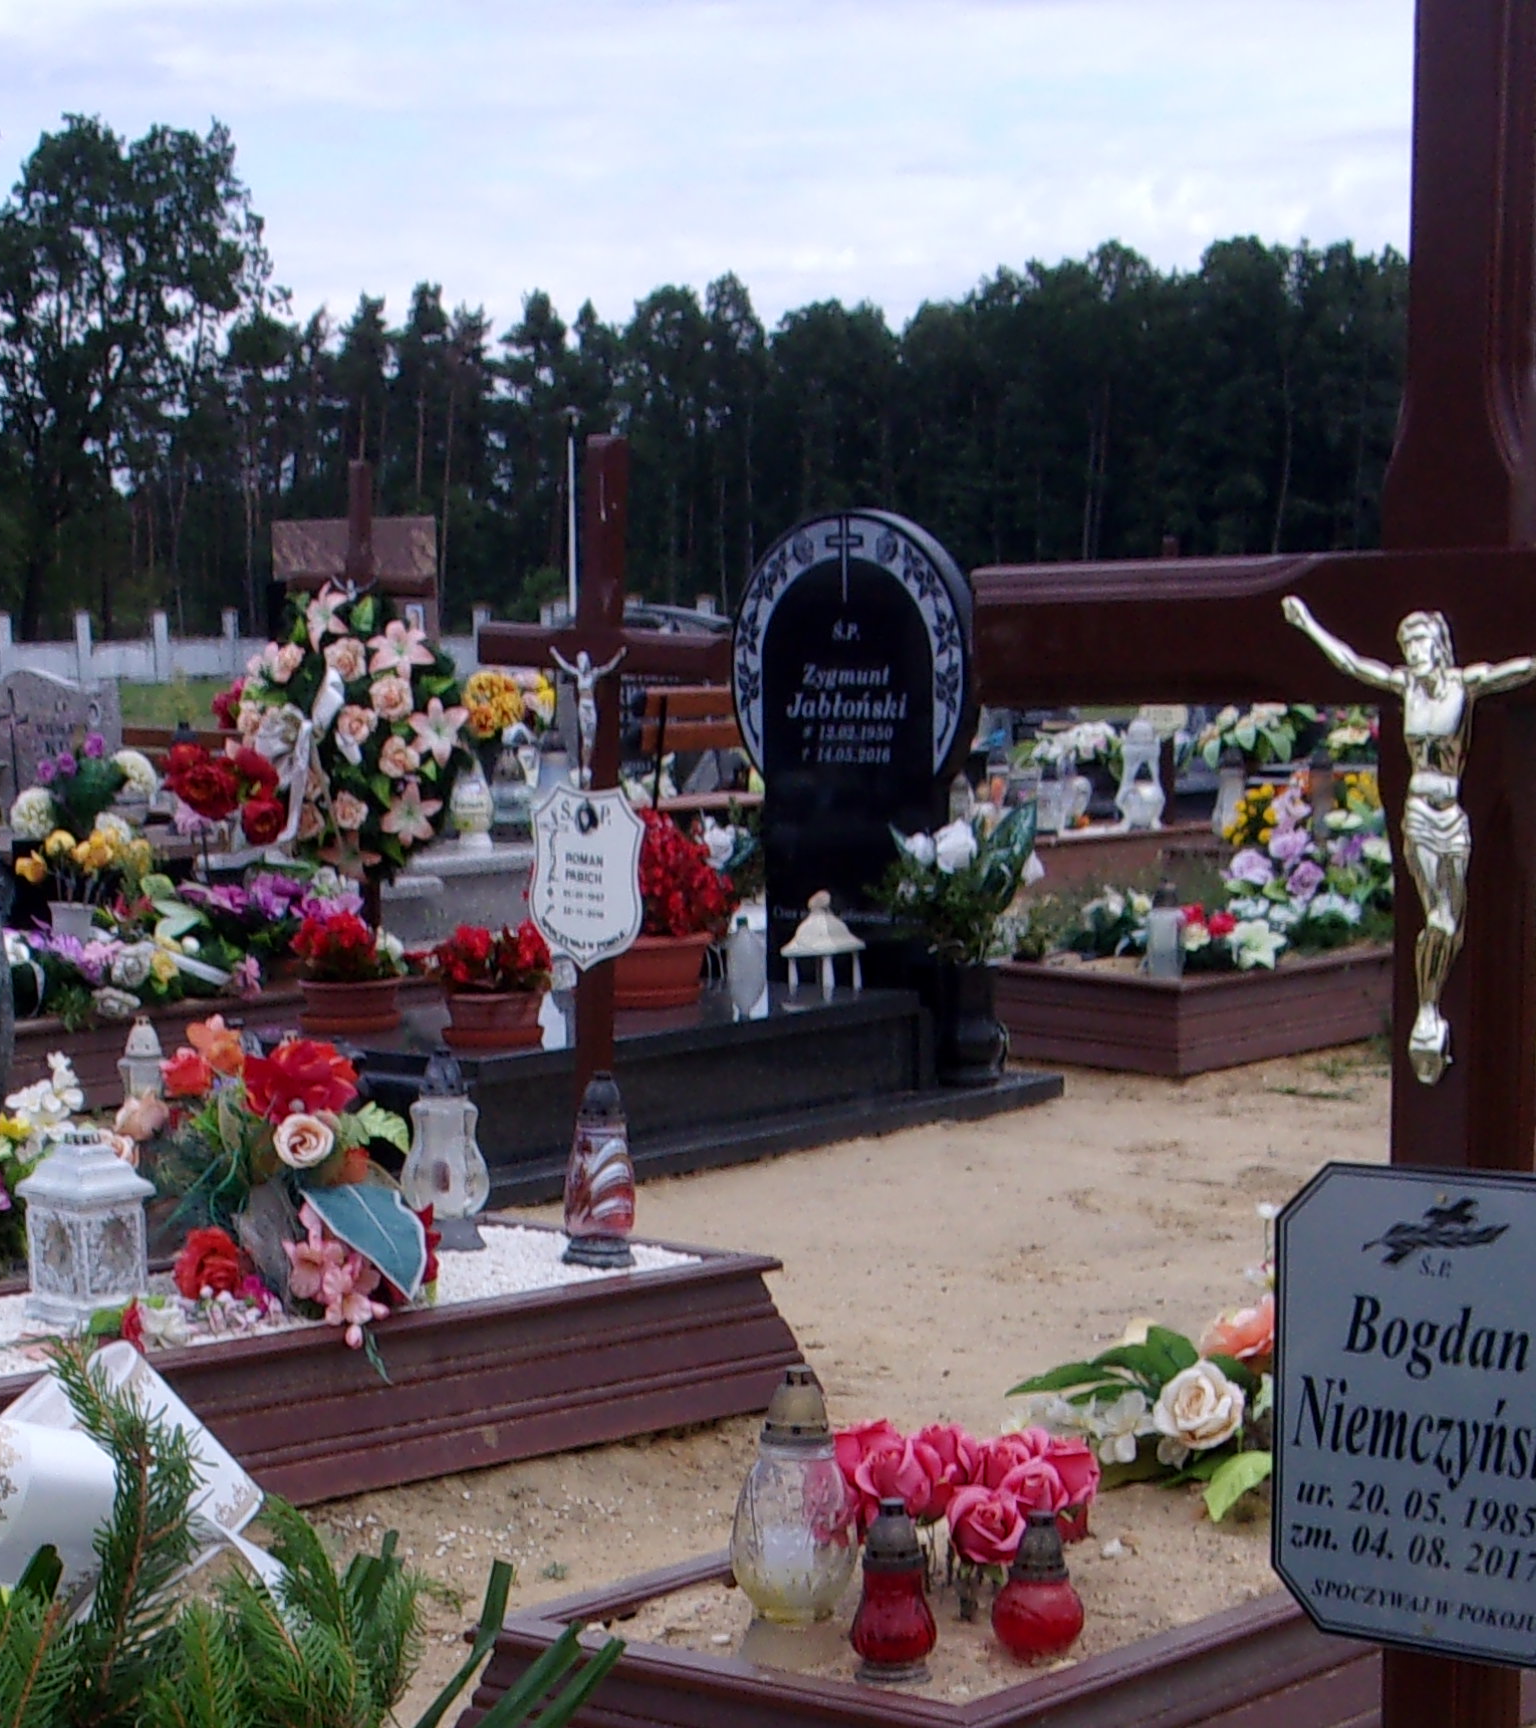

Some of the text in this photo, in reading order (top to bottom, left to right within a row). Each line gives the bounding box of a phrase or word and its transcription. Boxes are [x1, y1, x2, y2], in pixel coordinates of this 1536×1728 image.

[802, 662, 890, 691] Zygmunt
[786, 691, 907, 720] Jabłoński
[565, 852, 604, 868] ROMAN
[1344, 1294, 1531, 1381] Bogdan
[1296, 1480, 1335, 1509] ur.
[1347, 1481, 1390, 1516] 20.
[1404, 1491, 1447, 1527] 05.
[1290, 1522, 1338, 1551] zm.
[1350, 1524, 1394, 1561] 04.
[1408, 1534, 1452, 1570] 08.
[1311, 1578, 1434, 1615] SPOCZYWAJ
